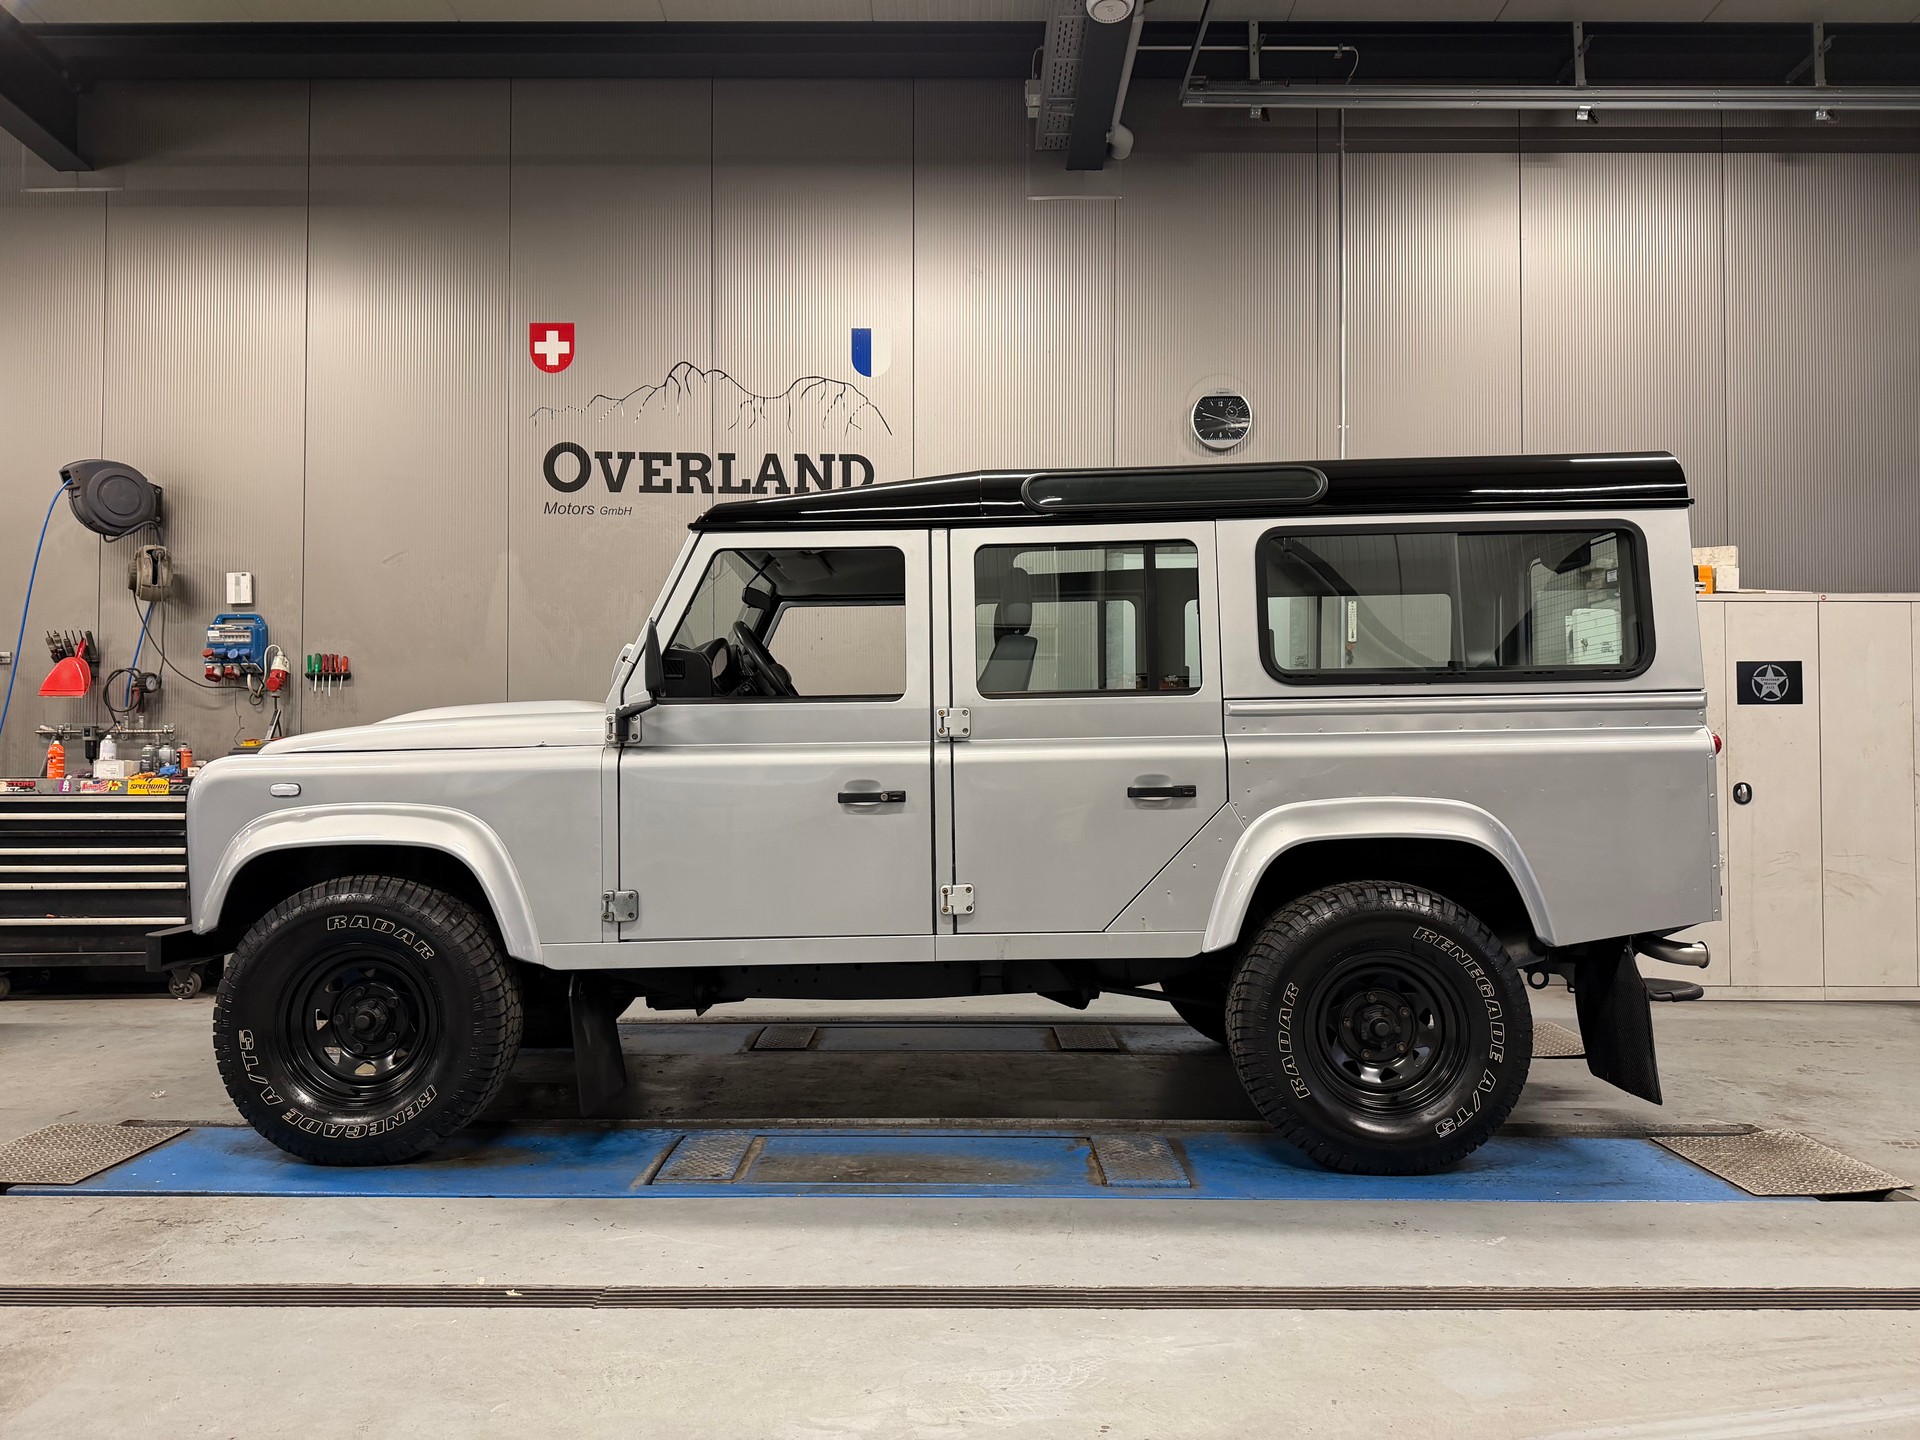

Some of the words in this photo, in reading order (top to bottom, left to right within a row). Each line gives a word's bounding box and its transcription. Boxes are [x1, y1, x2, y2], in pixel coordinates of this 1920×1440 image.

[543, 441, 875, 494] OVERLAND
[543, 501, 595, 516] Motors
[599, 505, 632, 516] GmbH
[130, 783, 168, 791] SPEEDWAY
[326, 914, 435, 960] RADAR
[1412, 925, 1506, 1063] RENEGADE
[1277, 981, 1311, 1099] RADAR
[281, 1083, 438, 1139] RENEGADE
